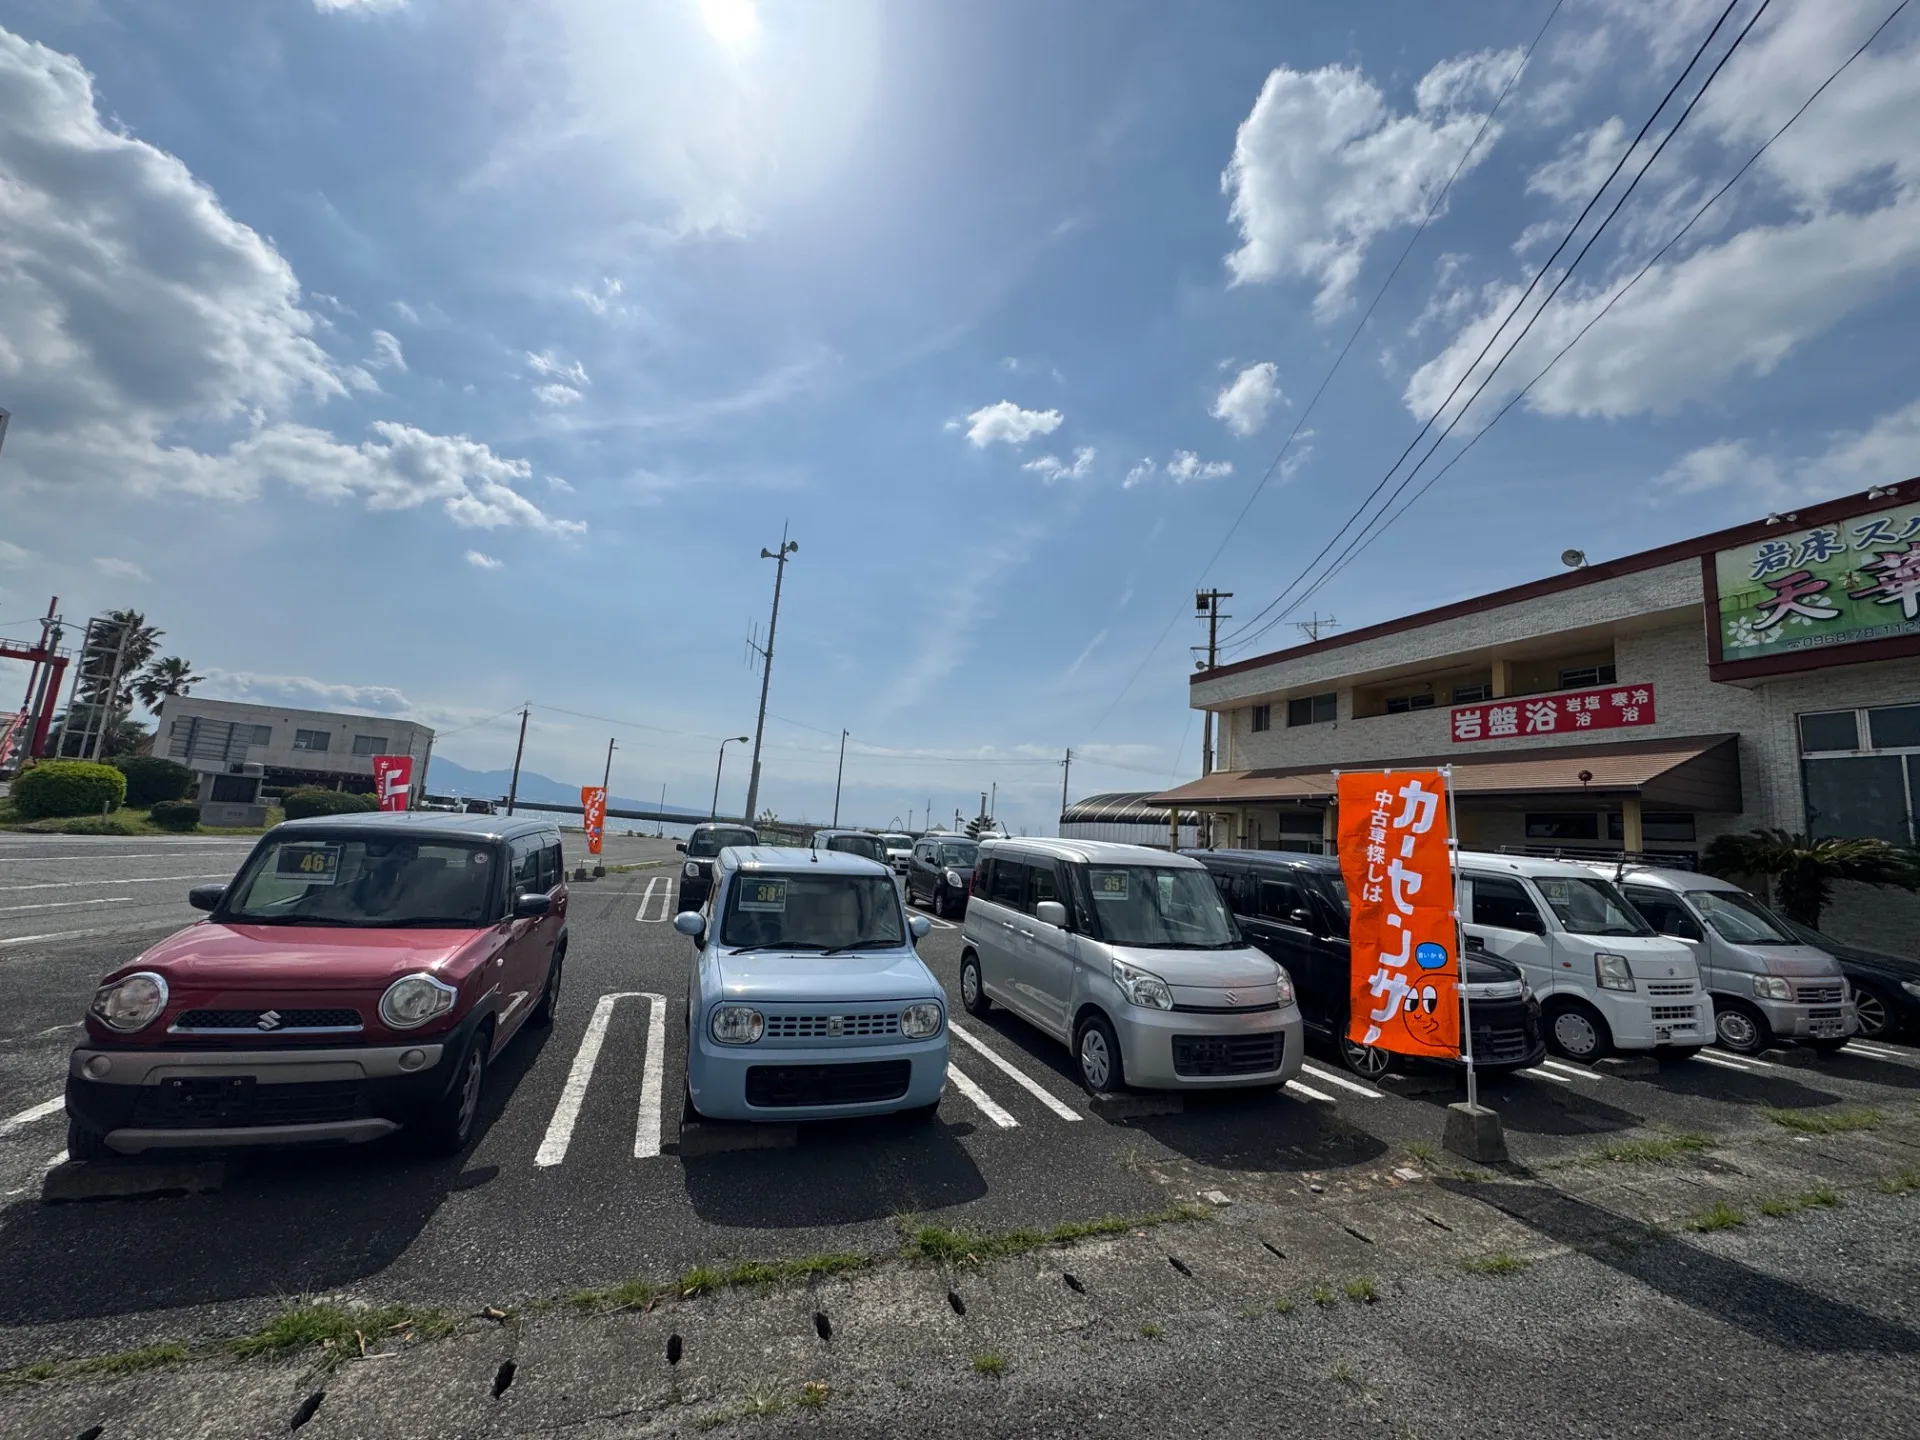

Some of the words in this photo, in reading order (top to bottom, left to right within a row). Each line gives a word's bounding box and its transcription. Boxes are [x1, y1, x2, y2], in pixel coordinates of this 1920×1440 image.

[1803, 633, 1846, 648] 0968
[1455, 700, 1557, 739] 岩盤浴
[1362, 790, 1393, 903] 中古車探しは
